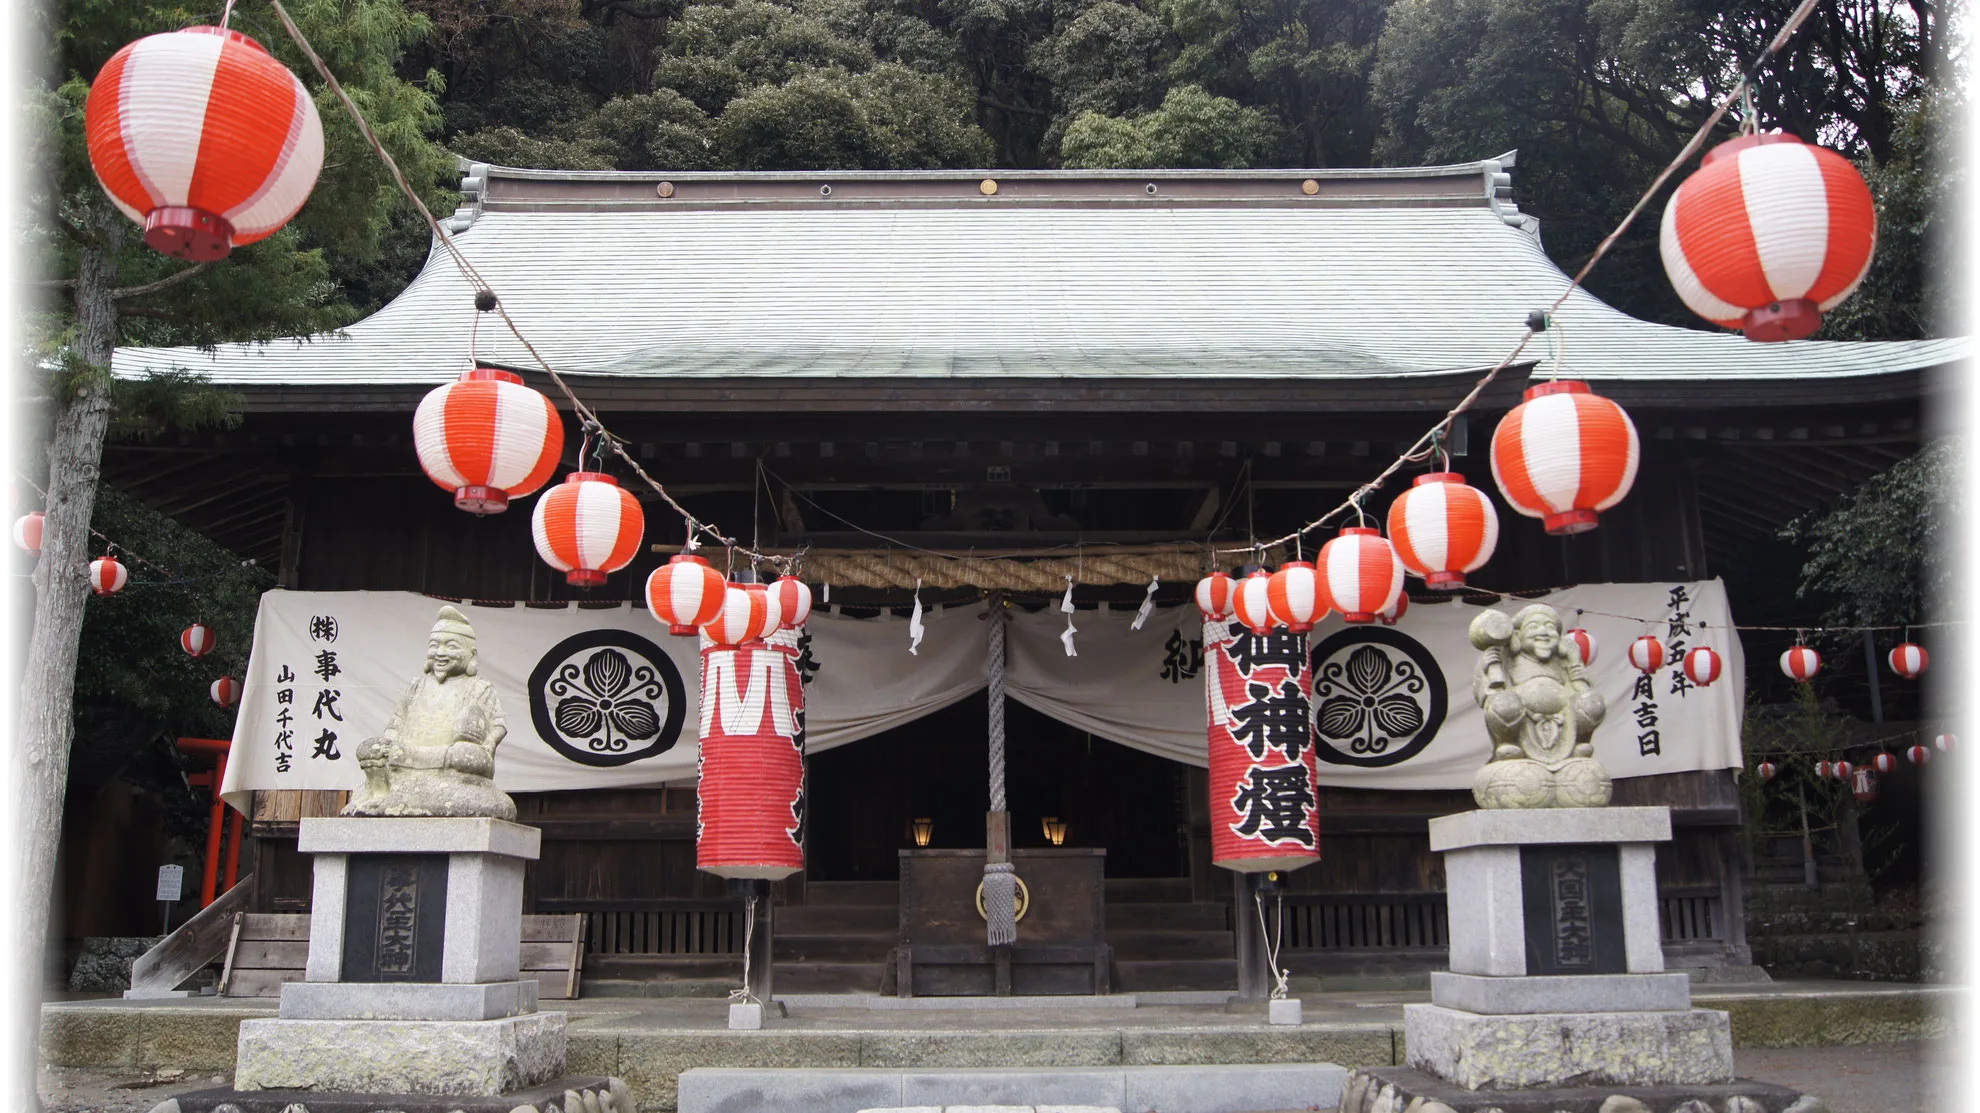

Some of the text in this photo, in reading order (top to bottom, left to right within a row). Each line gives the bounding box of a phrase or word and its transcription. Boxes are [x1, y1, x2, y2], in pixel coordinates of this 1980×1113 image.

[1667, 586, 1694, 698] 平成五年
[274, 664, 295, 773] 山田千代吉
